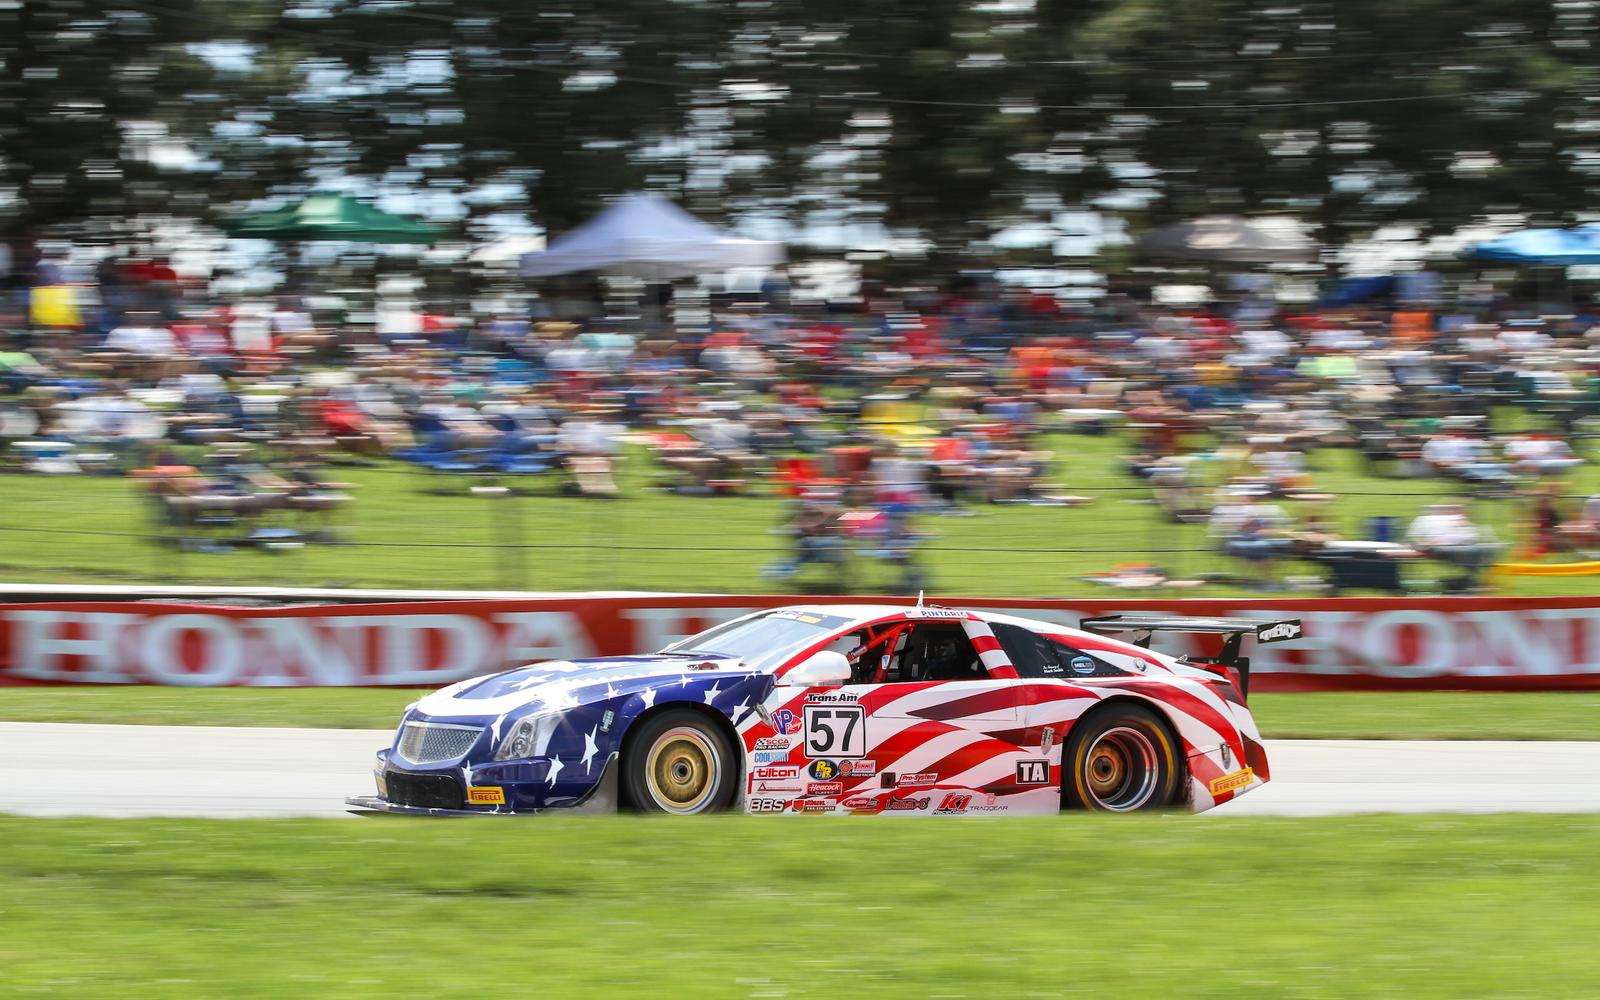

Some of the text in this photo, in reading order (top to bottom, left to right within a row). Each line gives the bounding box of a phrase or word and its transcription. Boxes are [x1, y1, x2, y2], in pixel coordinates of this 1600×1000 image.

[3, 609, 592, 687] HONDA
[808, 694, 857, 702] Trans Am
[773, 710, 793, 735] VP
[810, 710, 860, 752] 57
[756, 768, 797, 778] tilton
[1020, 762, 1045, 782] TA
[470, 790, 501, 801] PIRELLI
[937, 792, 972, 811] K1
[751, 799, 785, 812] BBS
